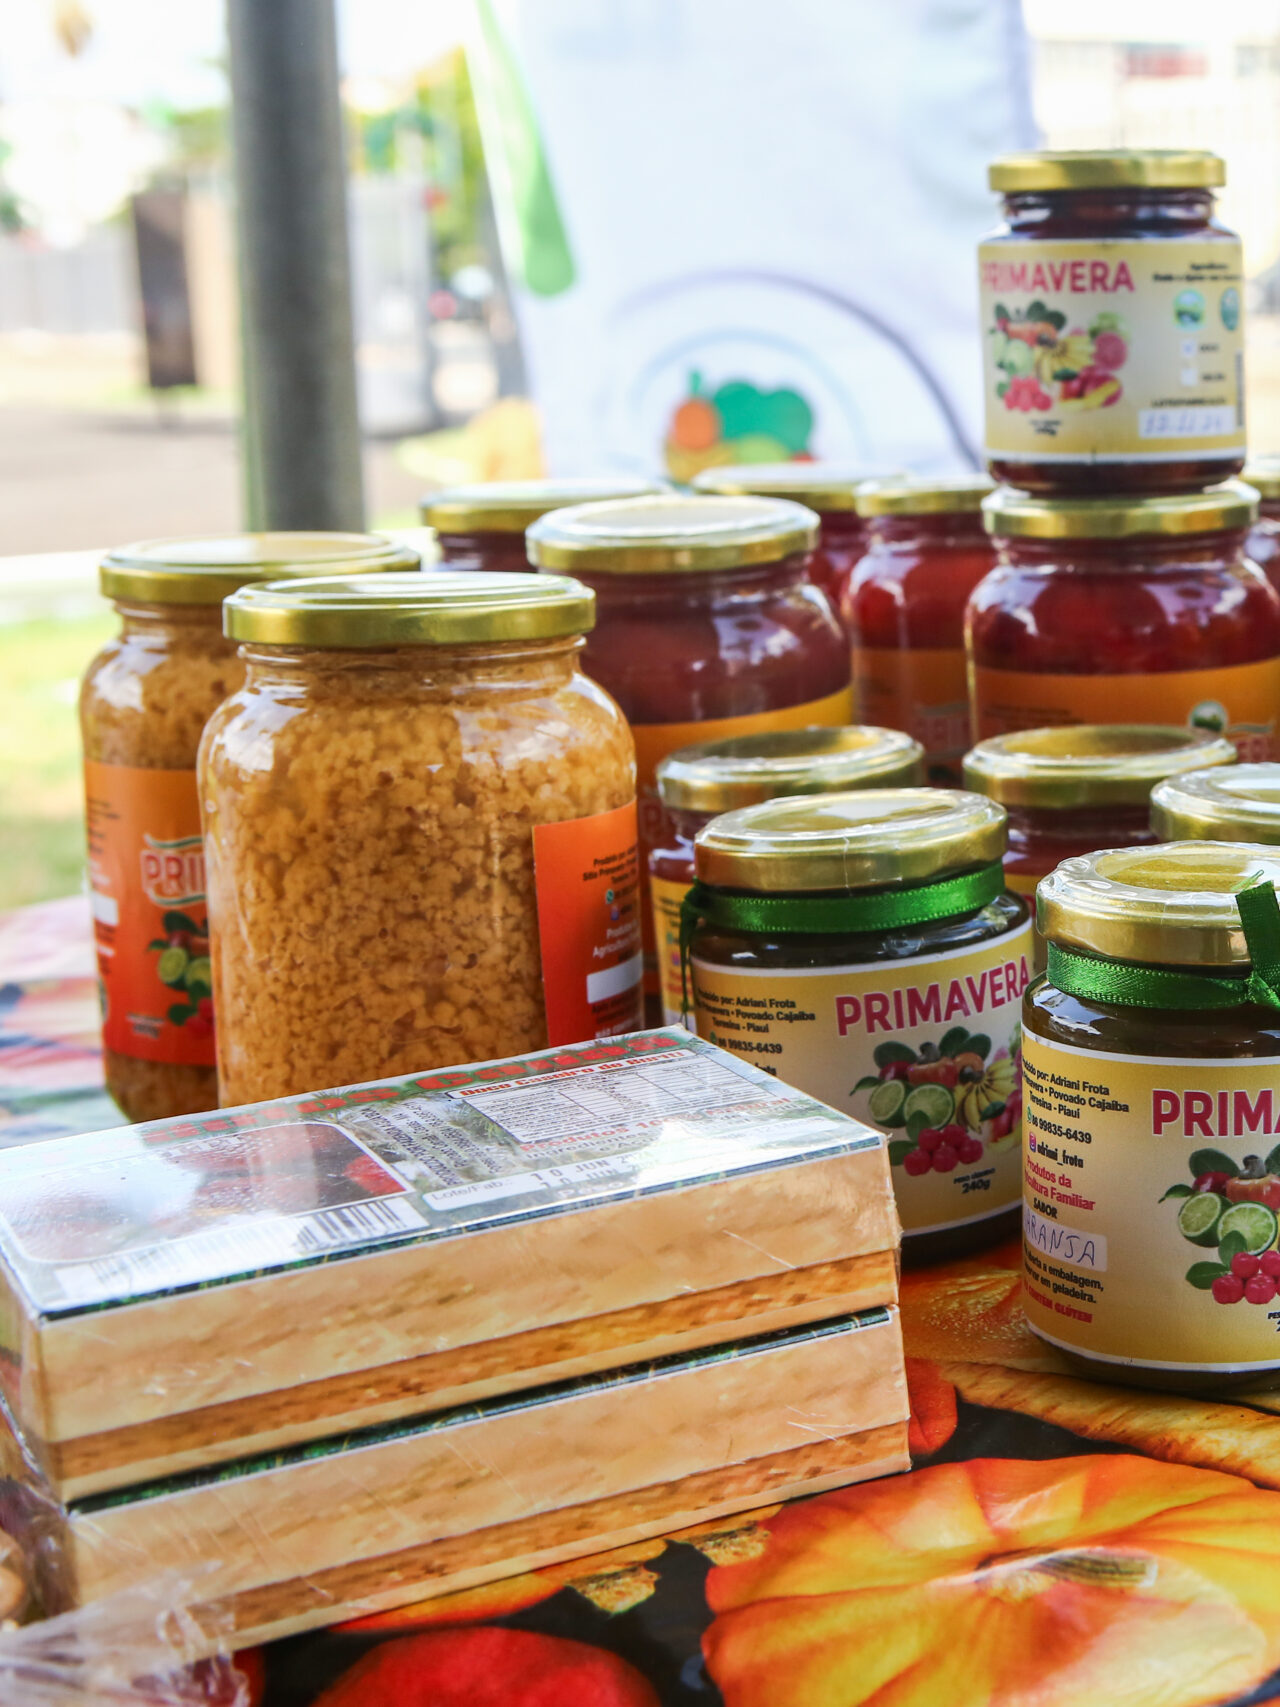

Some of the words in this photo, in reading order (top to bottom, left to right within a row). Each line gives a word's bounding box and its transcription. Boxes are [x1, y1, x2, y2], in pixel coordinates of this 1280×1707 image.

[769, 999, 796, 1008] Frota
[835, 954, 1031, 1037] PRIMAVERA
[735, 1009, 774, 1021] Povoado
[1037, 1069, 1049, 1082] por:
[1050, 1073, 1080, 1090] Adriani
[1082, 1081, 1110, 1096] Frota
[1029, 1091, 1053, 1111] Teresina
[1058, 1105, 1080, 1119] Piauí
[1049, 1087, 1086, 1107] Povoado
[1039, 1120, 1092, 1145] 99835-6439
[569, 1158, 612, 1172] JUN
[1026, 1155, 1057, 1184] Produtos
[1058, 1174, 1072, 1189] da
[962, 1179, 991, 1194] 240g
[1050, 1186, 1096, 1211] Familiar
[1033, 1197, 1058, 1219] SABOR
[1025, 1207, 1095, 1266] ARANJA
[1040, 1275, 1051, 1288] em
[1052, 1282, 1097, 1304] geladeira.
[1048, 1266, 1104, 1292] embalagem,
[1054, 1299, 1093, 1324] GLÚTEN
